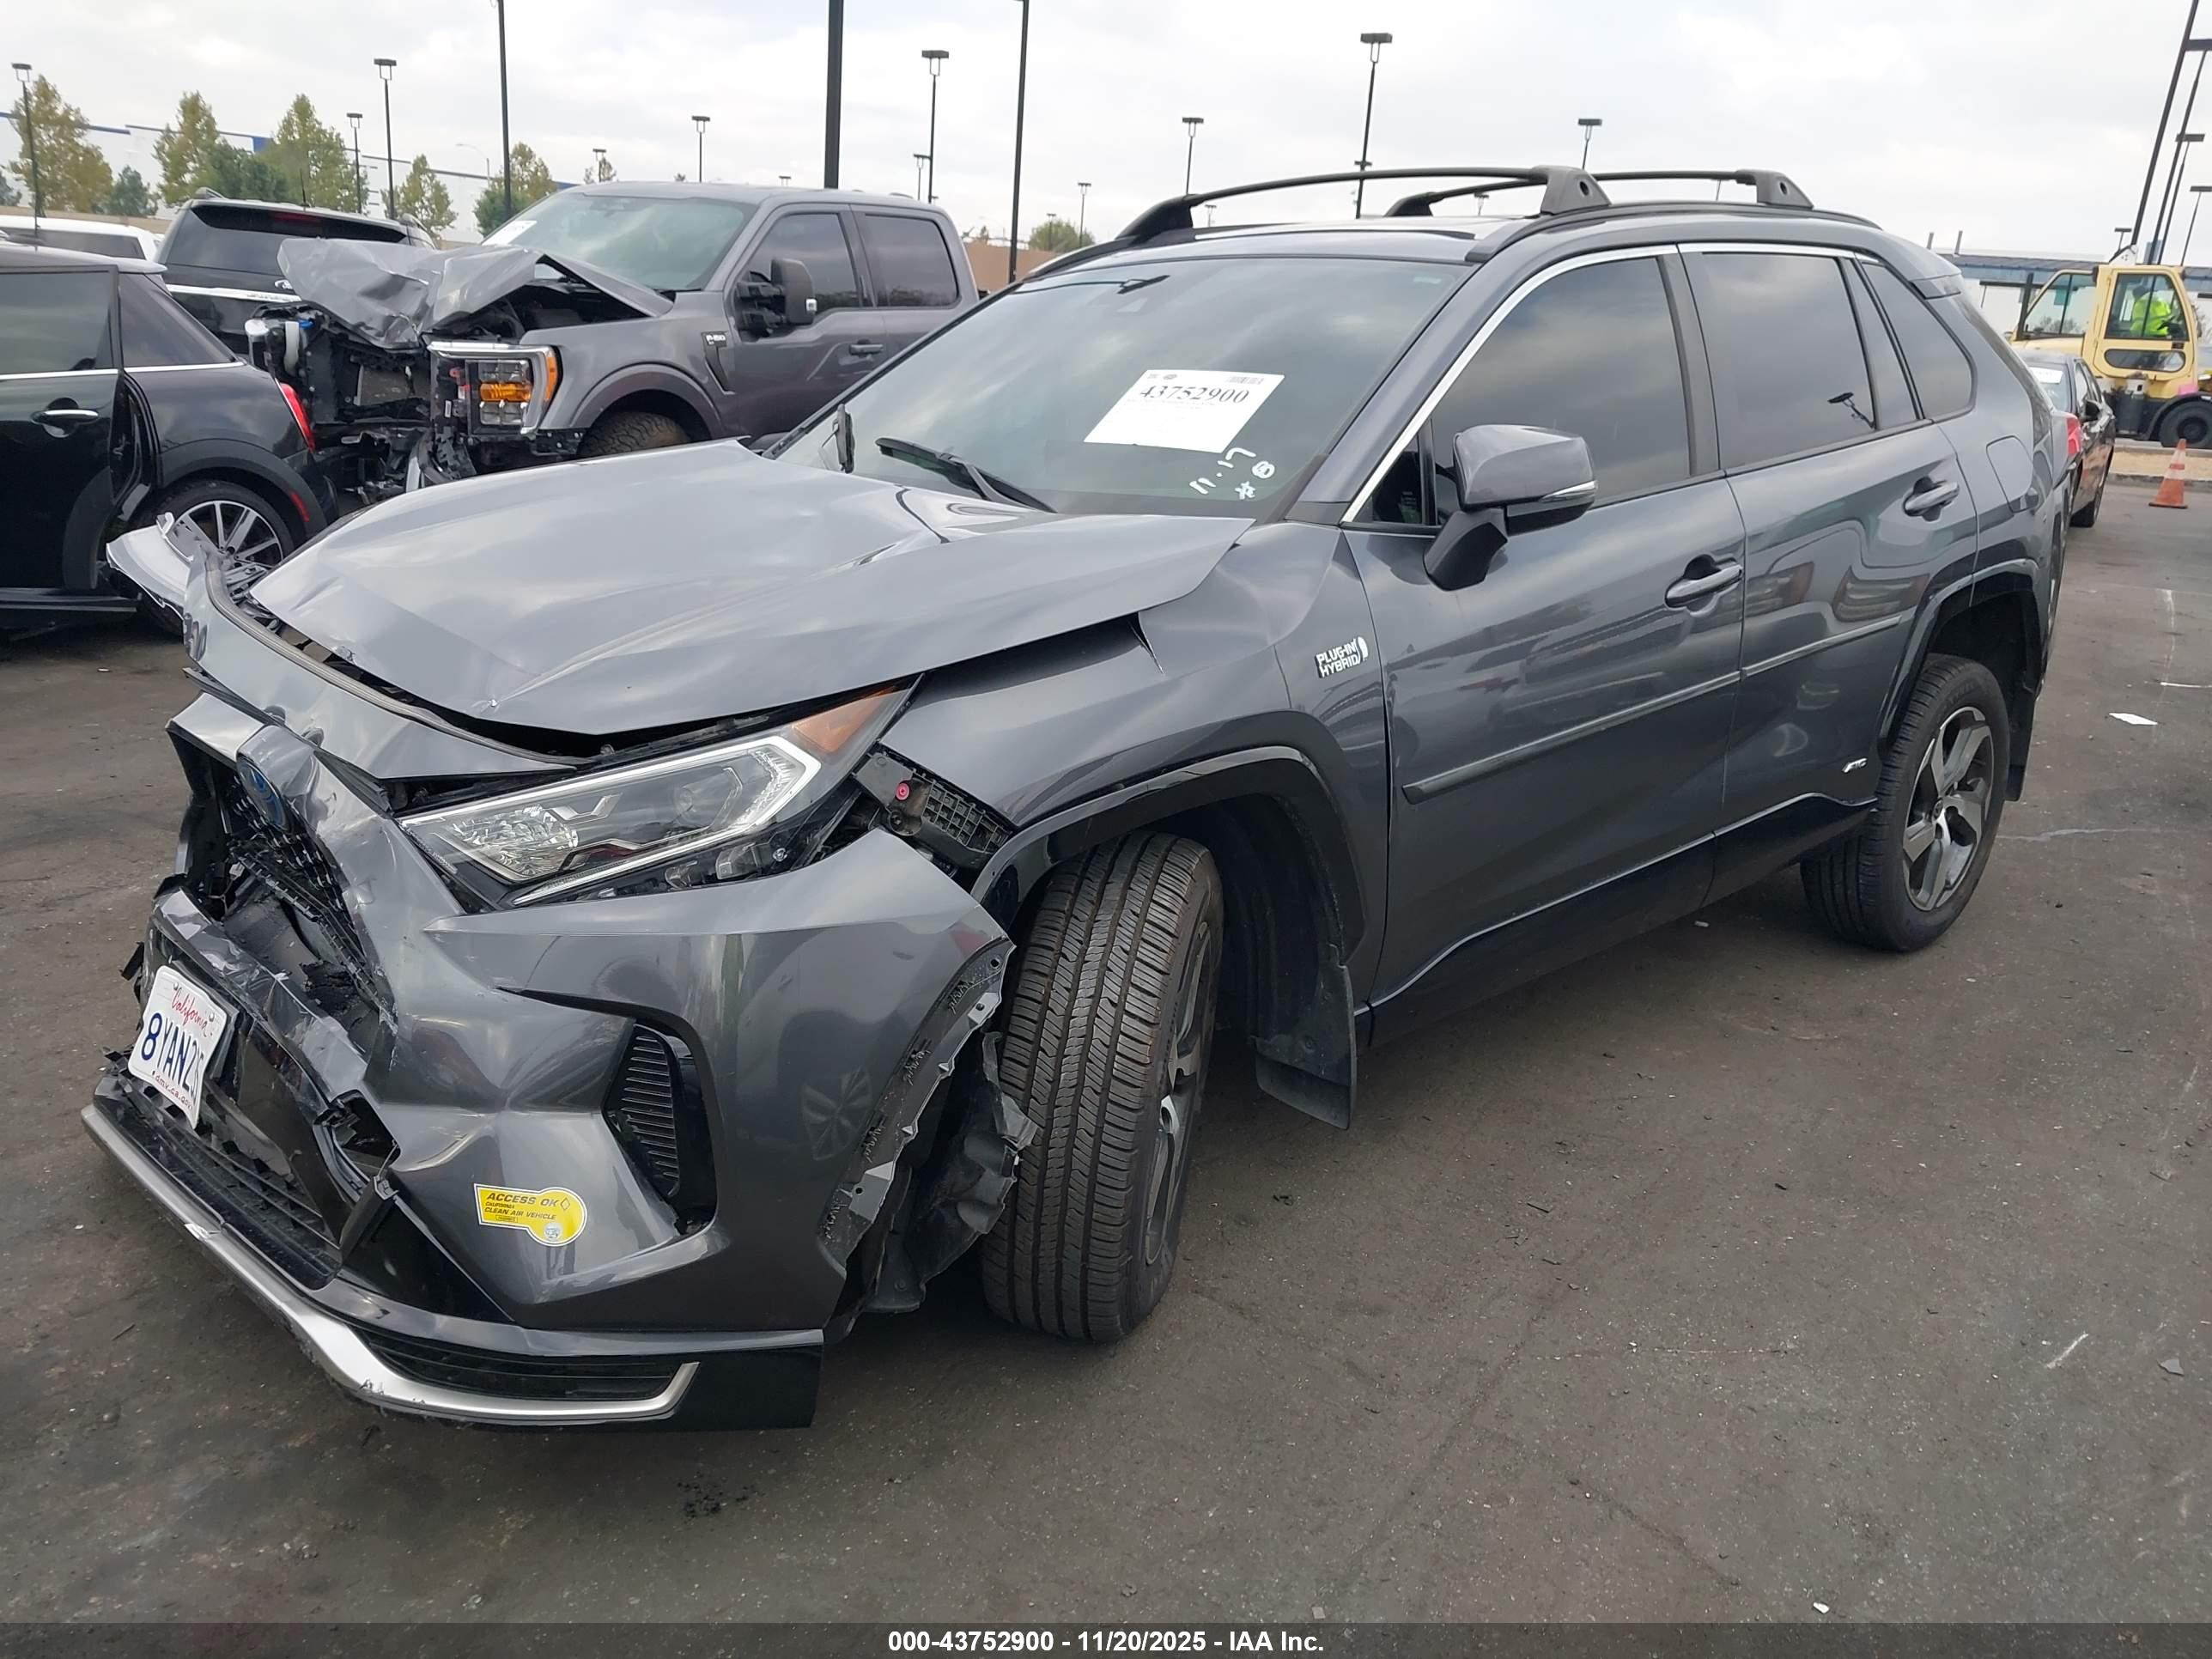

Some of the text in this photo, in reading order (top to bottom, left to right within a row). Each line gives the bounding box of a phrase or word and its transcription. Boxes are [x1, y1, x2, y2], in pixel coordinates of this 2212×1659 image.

[1140, 386, 1249, 404] 43752900
[1317, 638, 1358, 665] PLUG-IN
[1319, 653, 1359, 678] HYBRID
[171, 988, 209, 1033] California
[486, 1192, 560, 1207] ACCESS OK
[483, 1206, 509, 1215] CLEAN
[526, 1211, 557, 1220] VEHICLE
